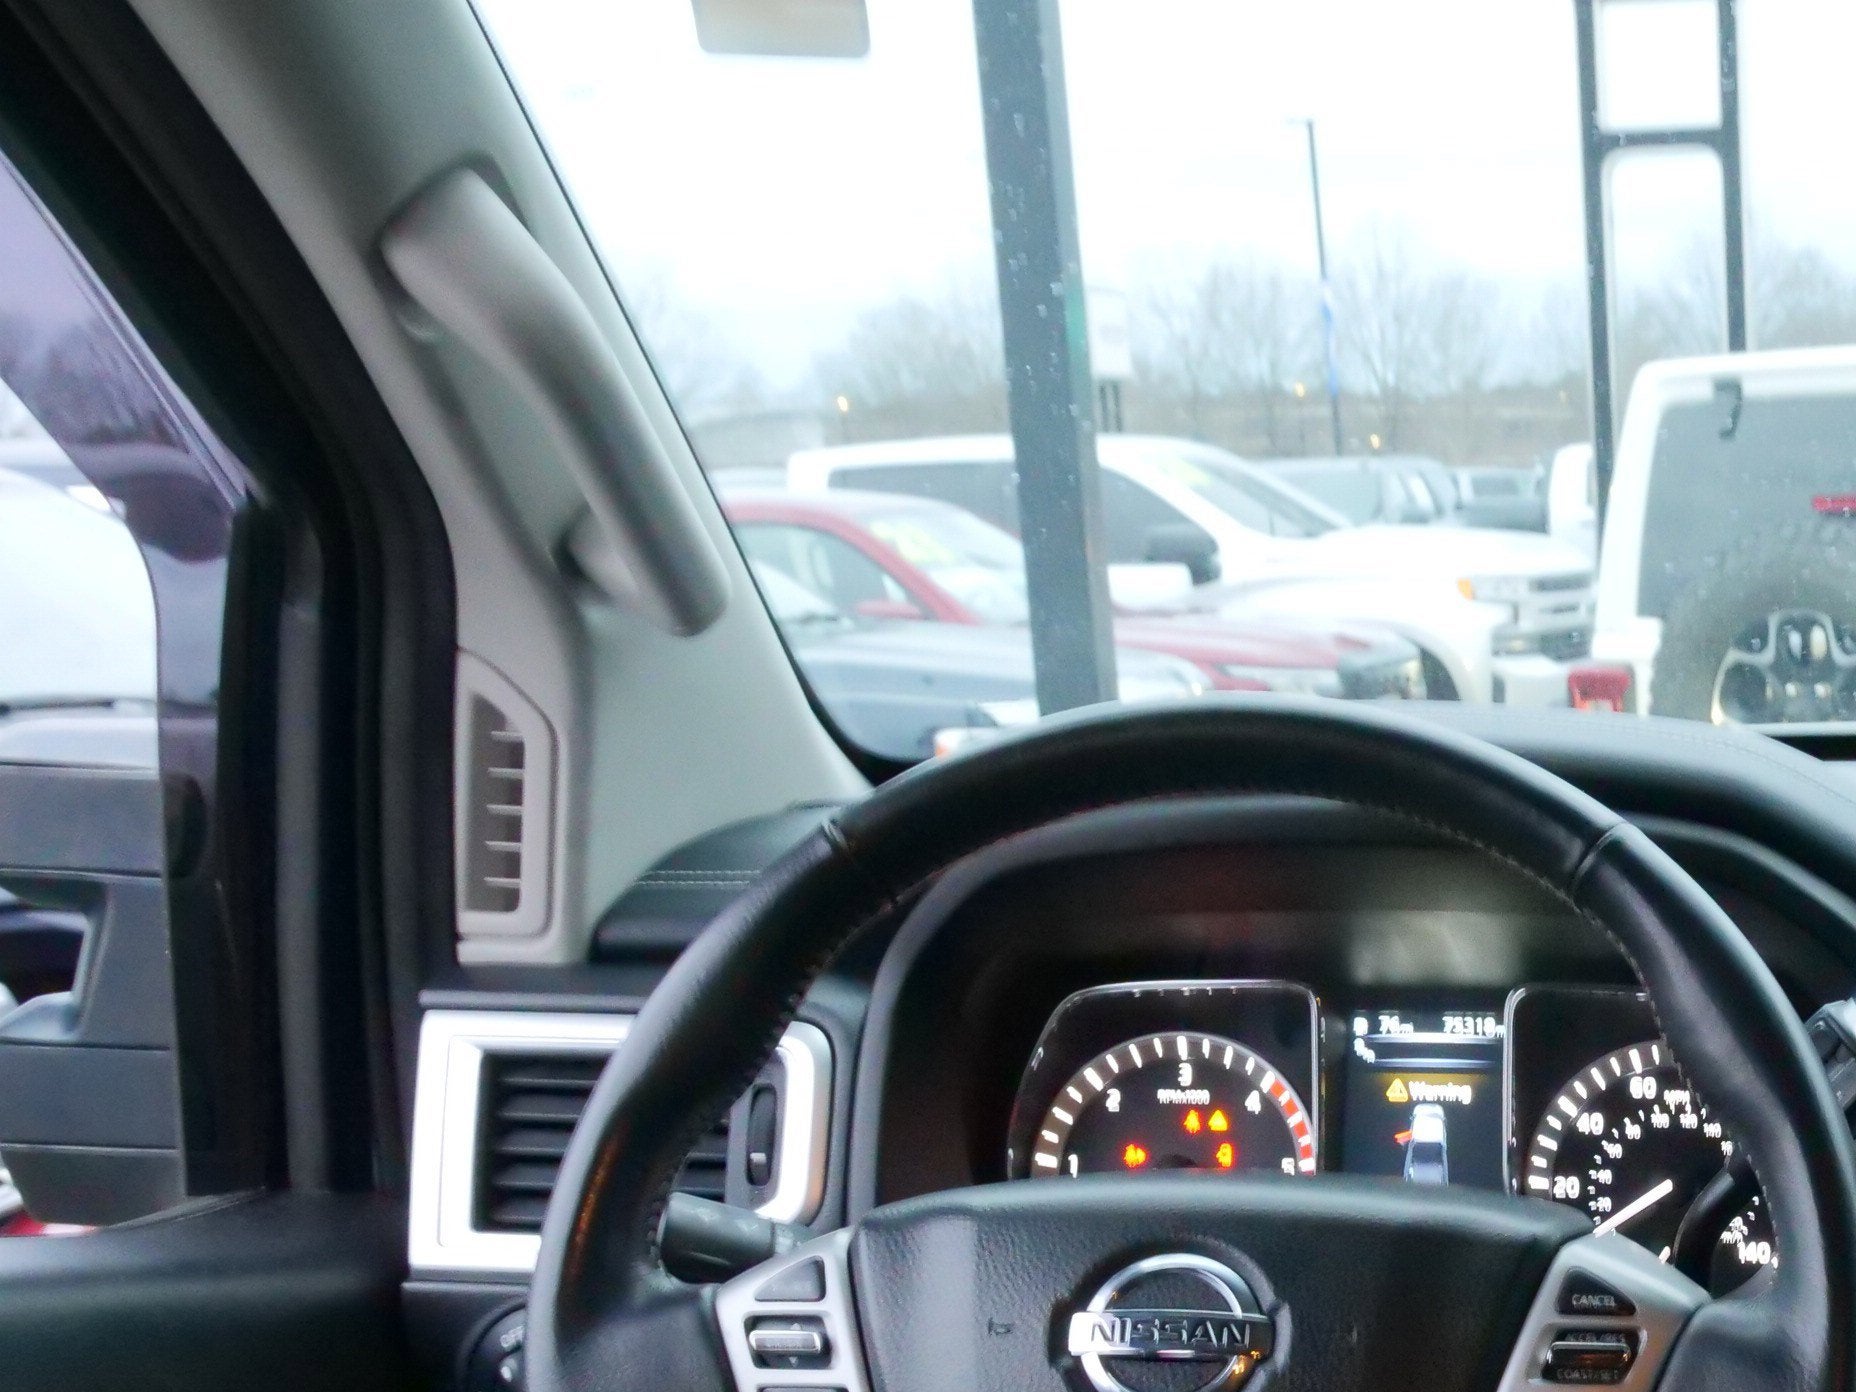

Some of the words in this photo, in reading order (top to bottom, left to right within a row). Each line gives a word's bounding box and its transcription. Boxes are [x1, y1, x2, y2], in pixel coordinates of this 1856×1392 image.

[1178, 1062, 1193, 1087] 3
[1629, 1076, 1657, 1099] 60
[1105, 1088, 1121, 1112] 2
[1244, 1090, 1261, 1114] 4
[1576, 1112, 1604, 1135] 40
[1553, 1175, 1580, 1199] 20
[1737, 1241, 1770, 1264] 140
[1090, 1316, 1251, 1350] NISSAN
